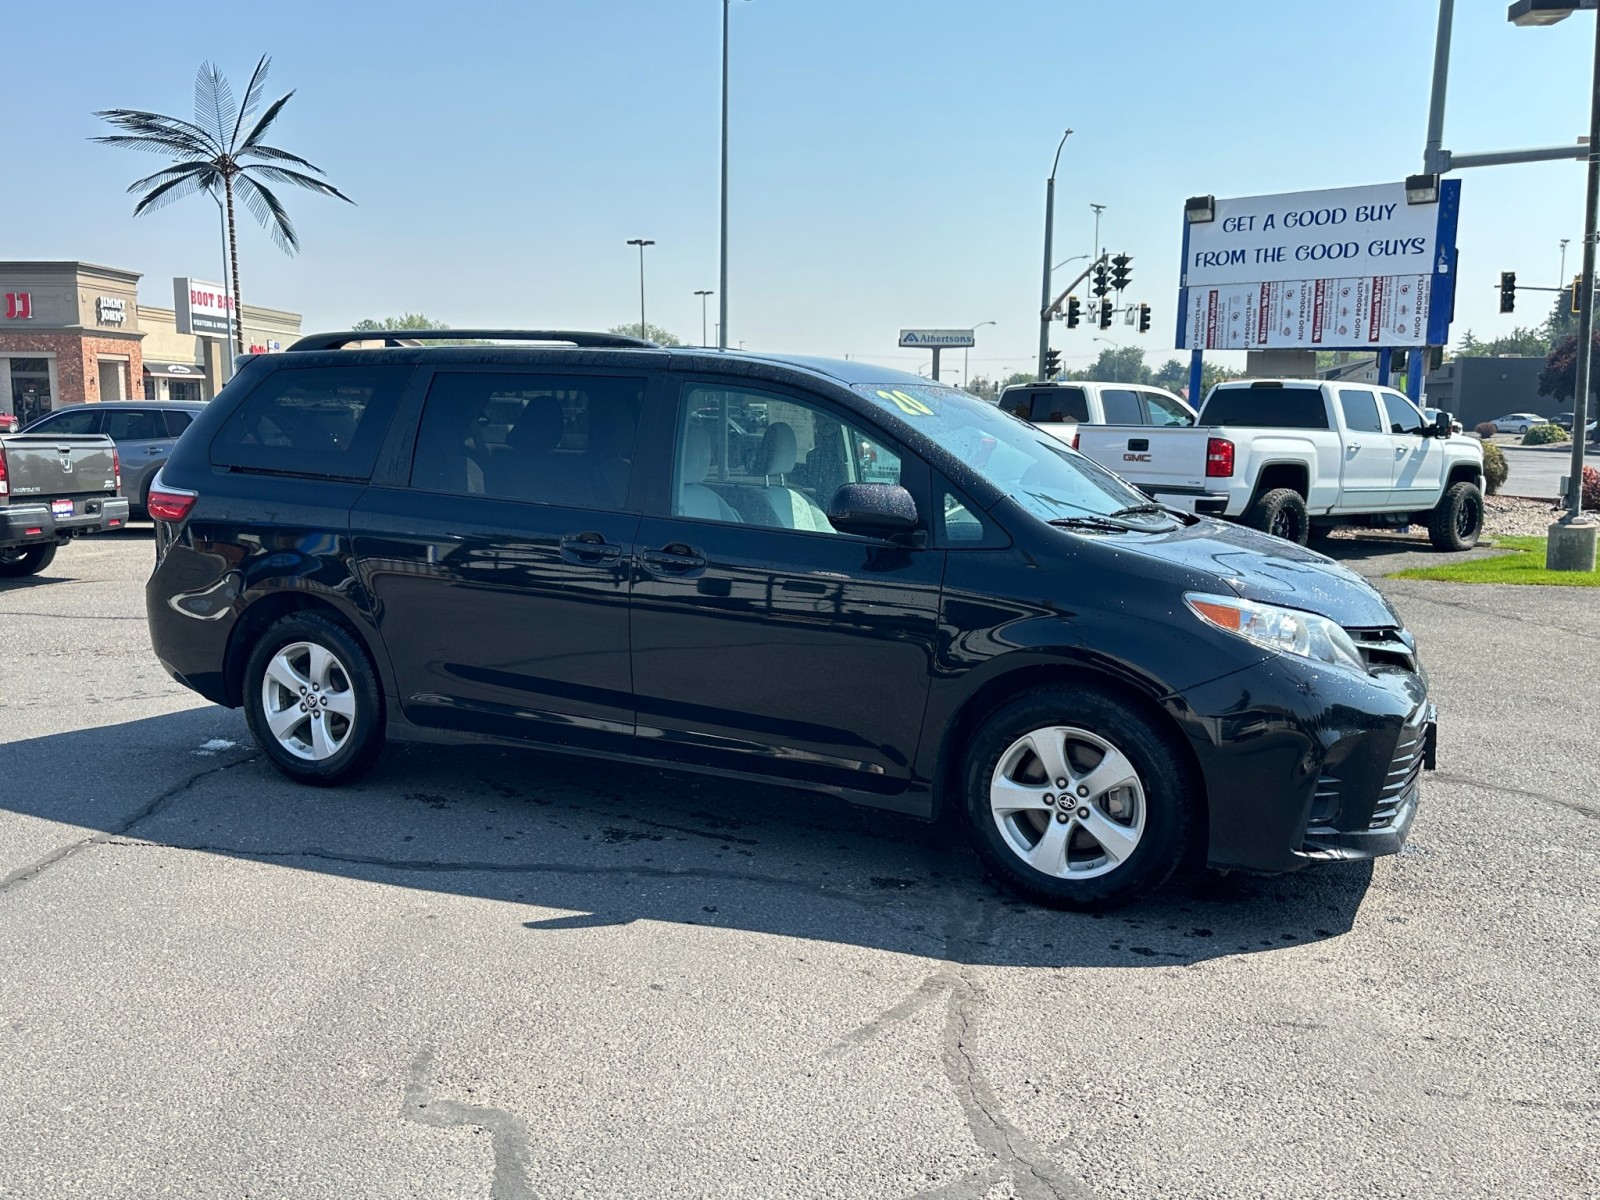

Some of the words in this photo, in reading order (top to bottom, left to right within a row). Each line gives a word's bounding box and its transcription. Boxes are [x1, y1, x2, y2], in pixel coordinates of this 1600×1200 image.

[1222, 216, 1256, 232] GET
[1263, 214, 1276, 232] A
[1284, 208, 1347, 228] GOOD
[1355, 203, 1397, 222] BUY
[1195, 250, 1246, 267] FROM
[1254, 246, 1287, 264] THE
[1295, 241, 1359, 262] GOOD
[1368, 237, 1425, 257] GUYS
[100, 296, 126, 310] JIMMY
[190, 290, 214, 308] BOOT
[218, 294, 236, 310] BAR
[101, 309, 126, 322] JOHN'S
[876, 390, 934, 416] 20
[1123, 454, 1152, 462] GMC
